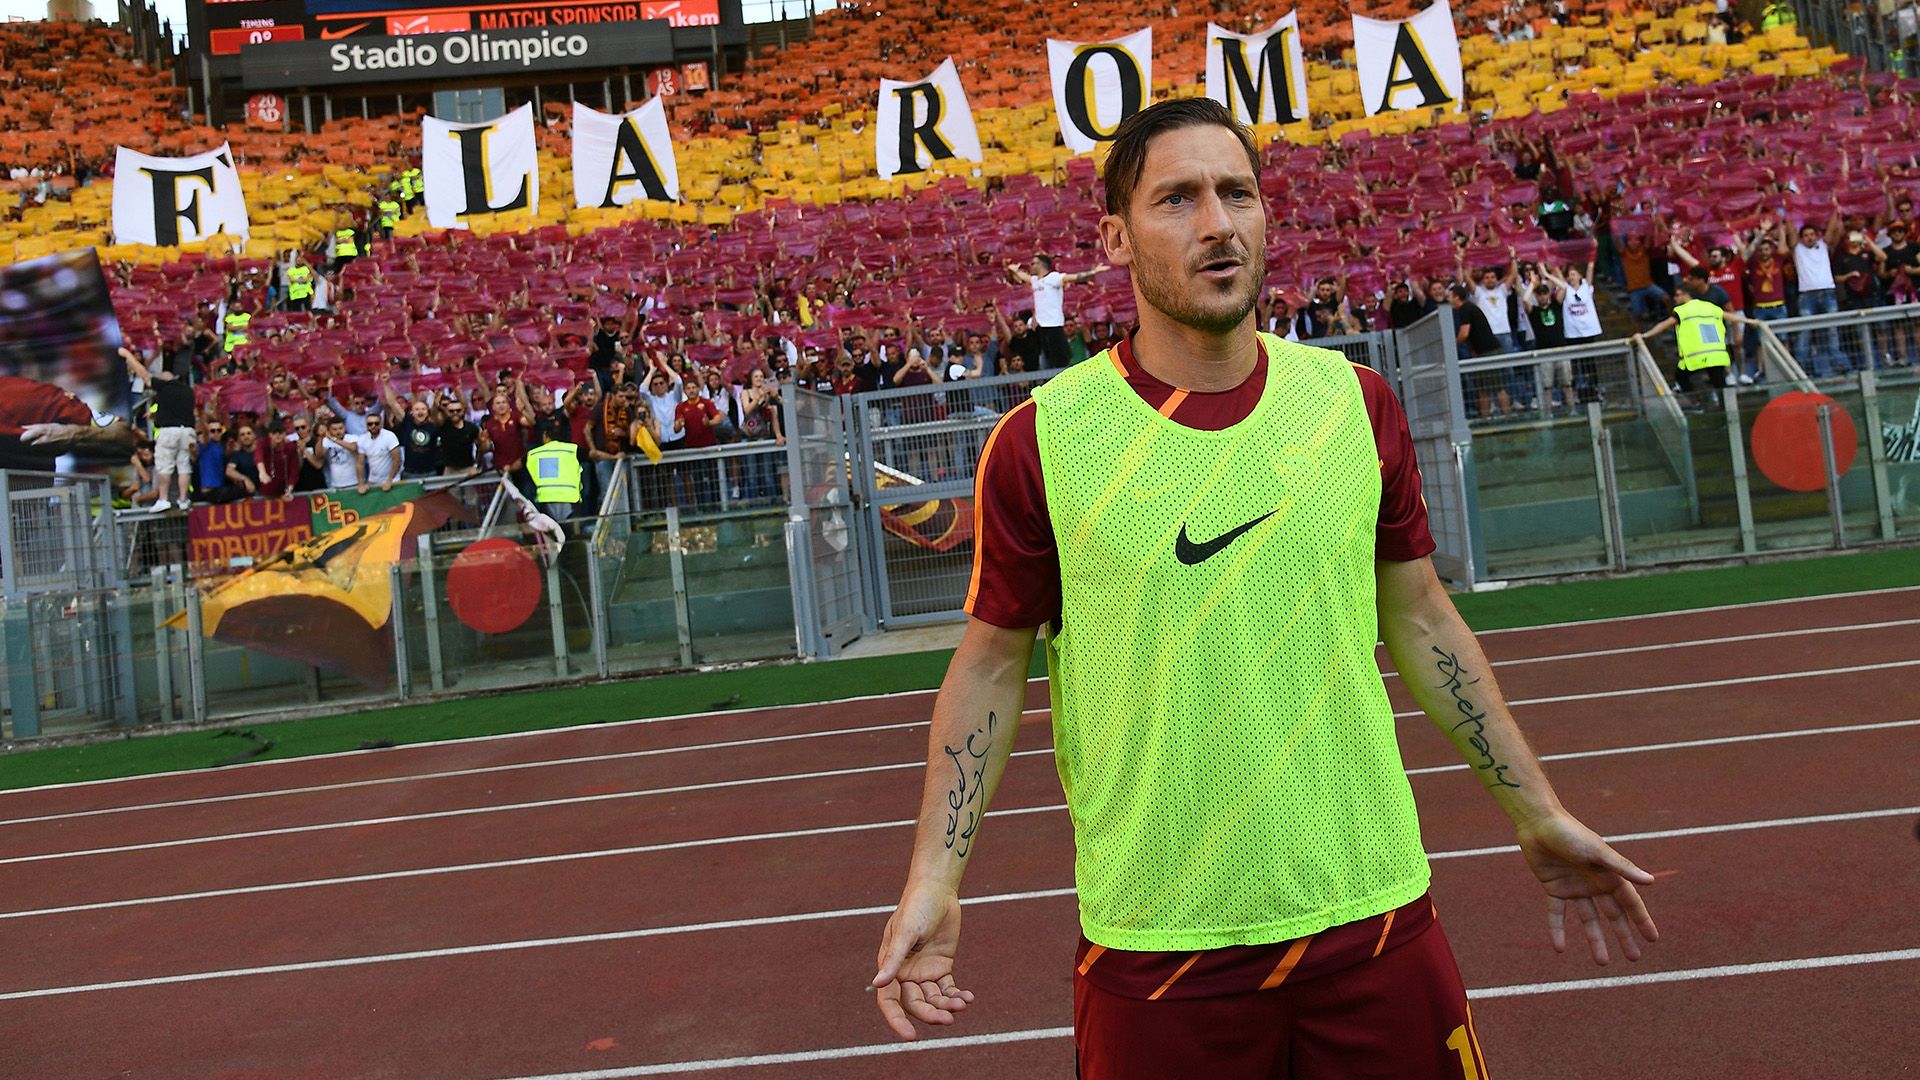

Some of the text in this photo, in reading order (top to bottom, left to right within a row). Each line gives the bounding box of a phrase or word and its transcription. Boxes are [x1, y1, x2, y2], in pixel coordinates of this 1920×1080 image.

[240, 18, 275, 29] TIMING
[479, 5, 638, 30] MATCH SPONSOR
[330, 30, 588, 72] Stadio Olimpico
[208, 499, 286, 531] LUCA
